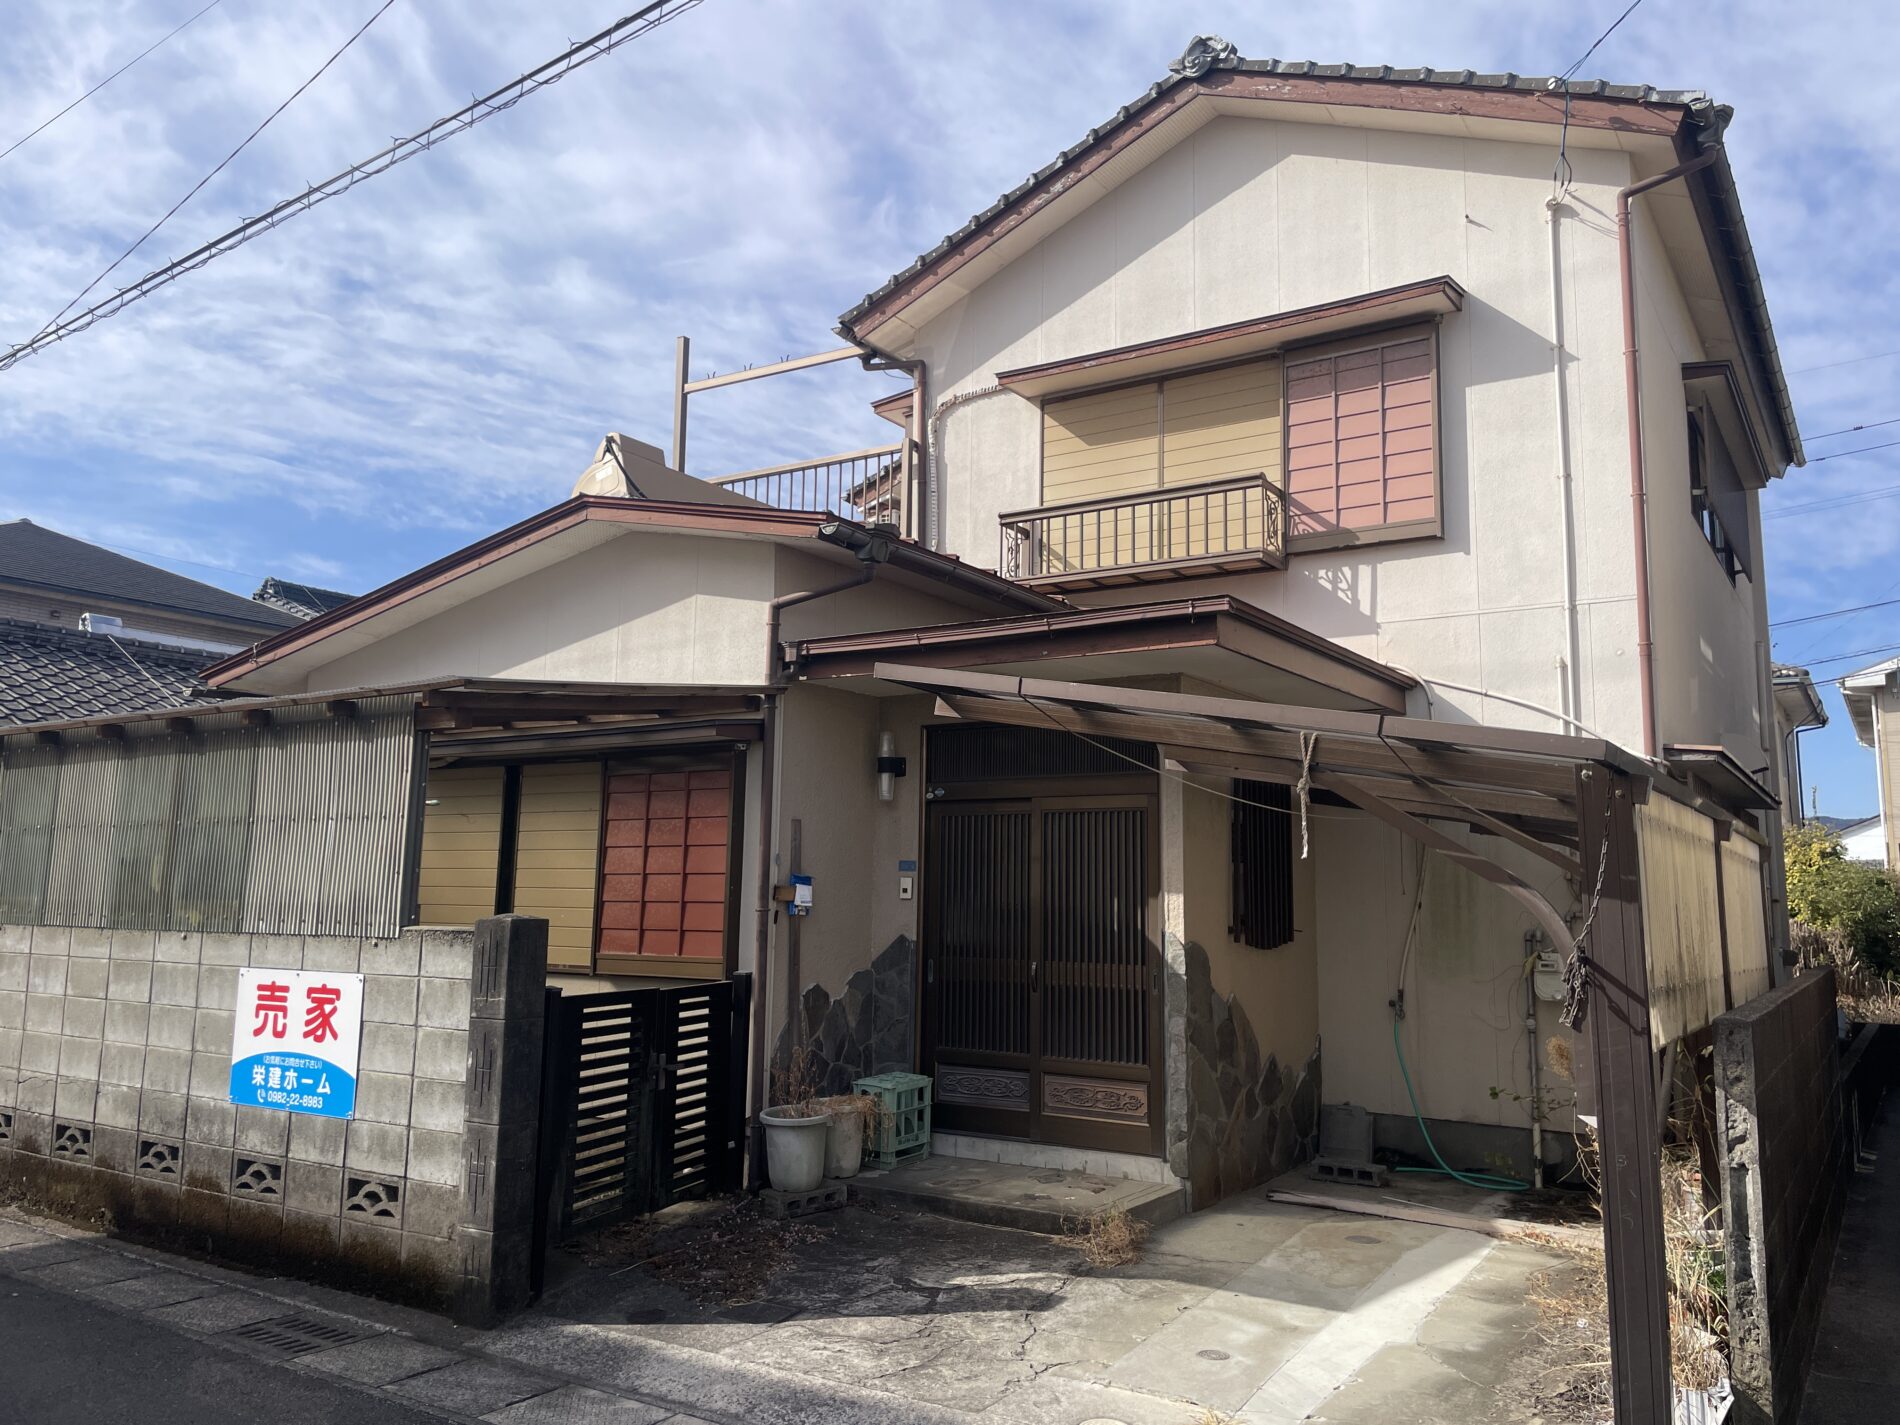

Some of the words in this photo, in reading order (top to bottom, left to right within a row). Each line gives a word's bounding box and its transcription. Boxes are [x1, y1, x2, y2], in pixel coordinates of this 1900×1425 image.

[252, 980, 341, 1043] 売家
[251, 1064, 331, 1095] 栄建ホーム
[267, 1091, 323, 1109] 0982-22-8983
